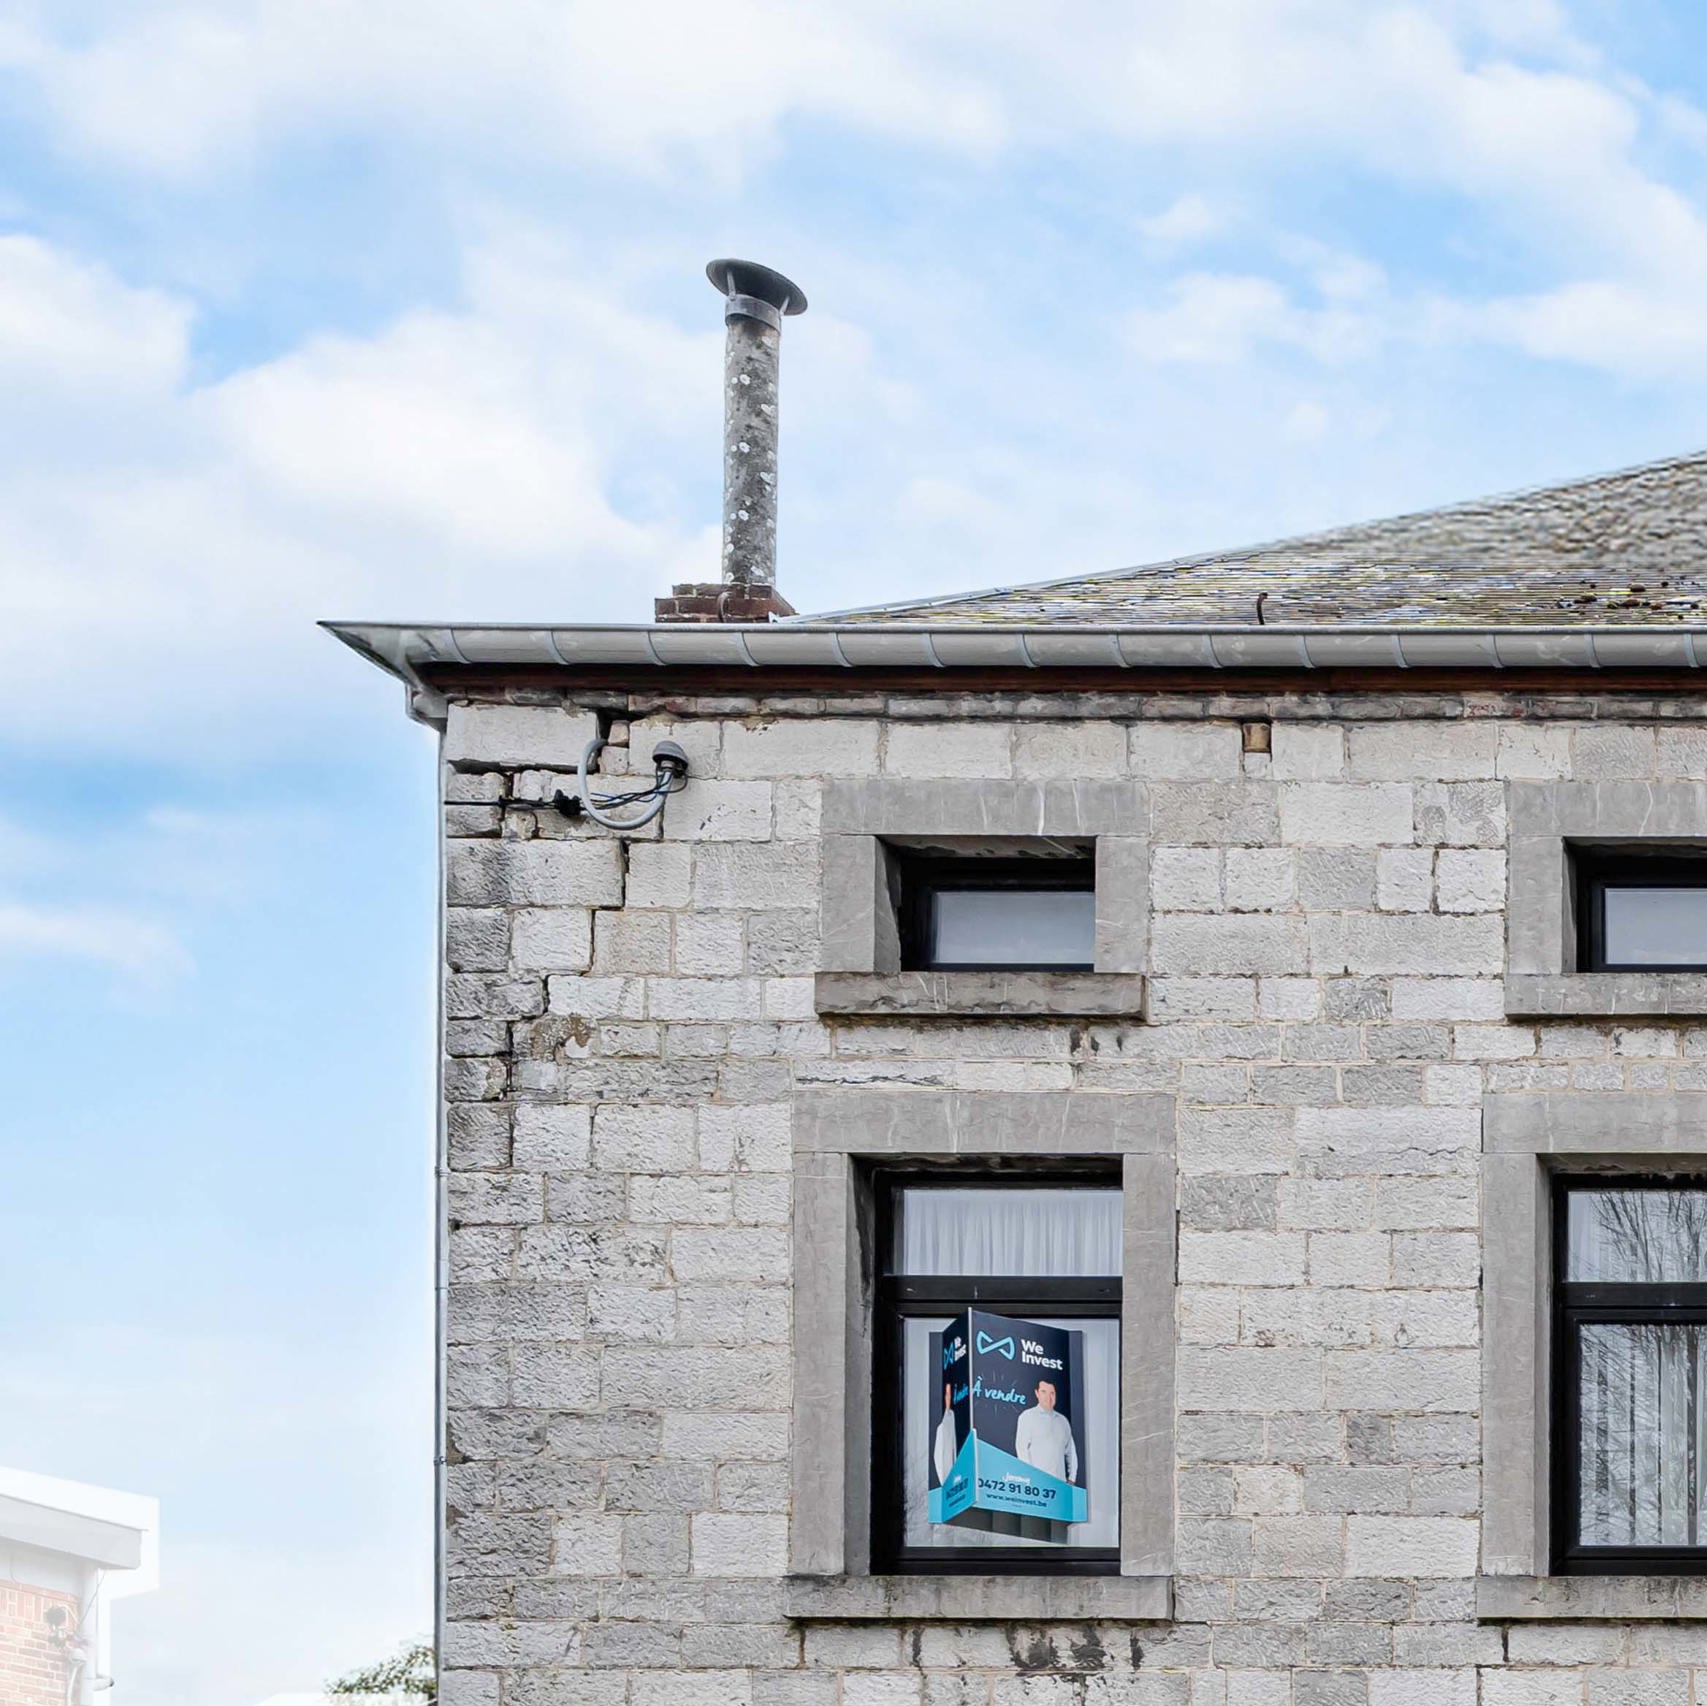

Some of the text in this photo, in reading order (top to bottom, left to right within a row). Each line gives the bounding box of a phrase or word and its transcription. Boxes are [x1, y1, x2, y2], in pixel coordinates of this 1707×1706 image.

[1020, 1339, 1044, 1355] We
[1021, 1350, 1063, 1370] Invest
[985, 1386, 1026, 1405] vendre
[1008, 1483, 1022, 1494] 91
[1024, 1485, 1040, 1497] 80
[1042, 1488, 1057, 1500] 37
